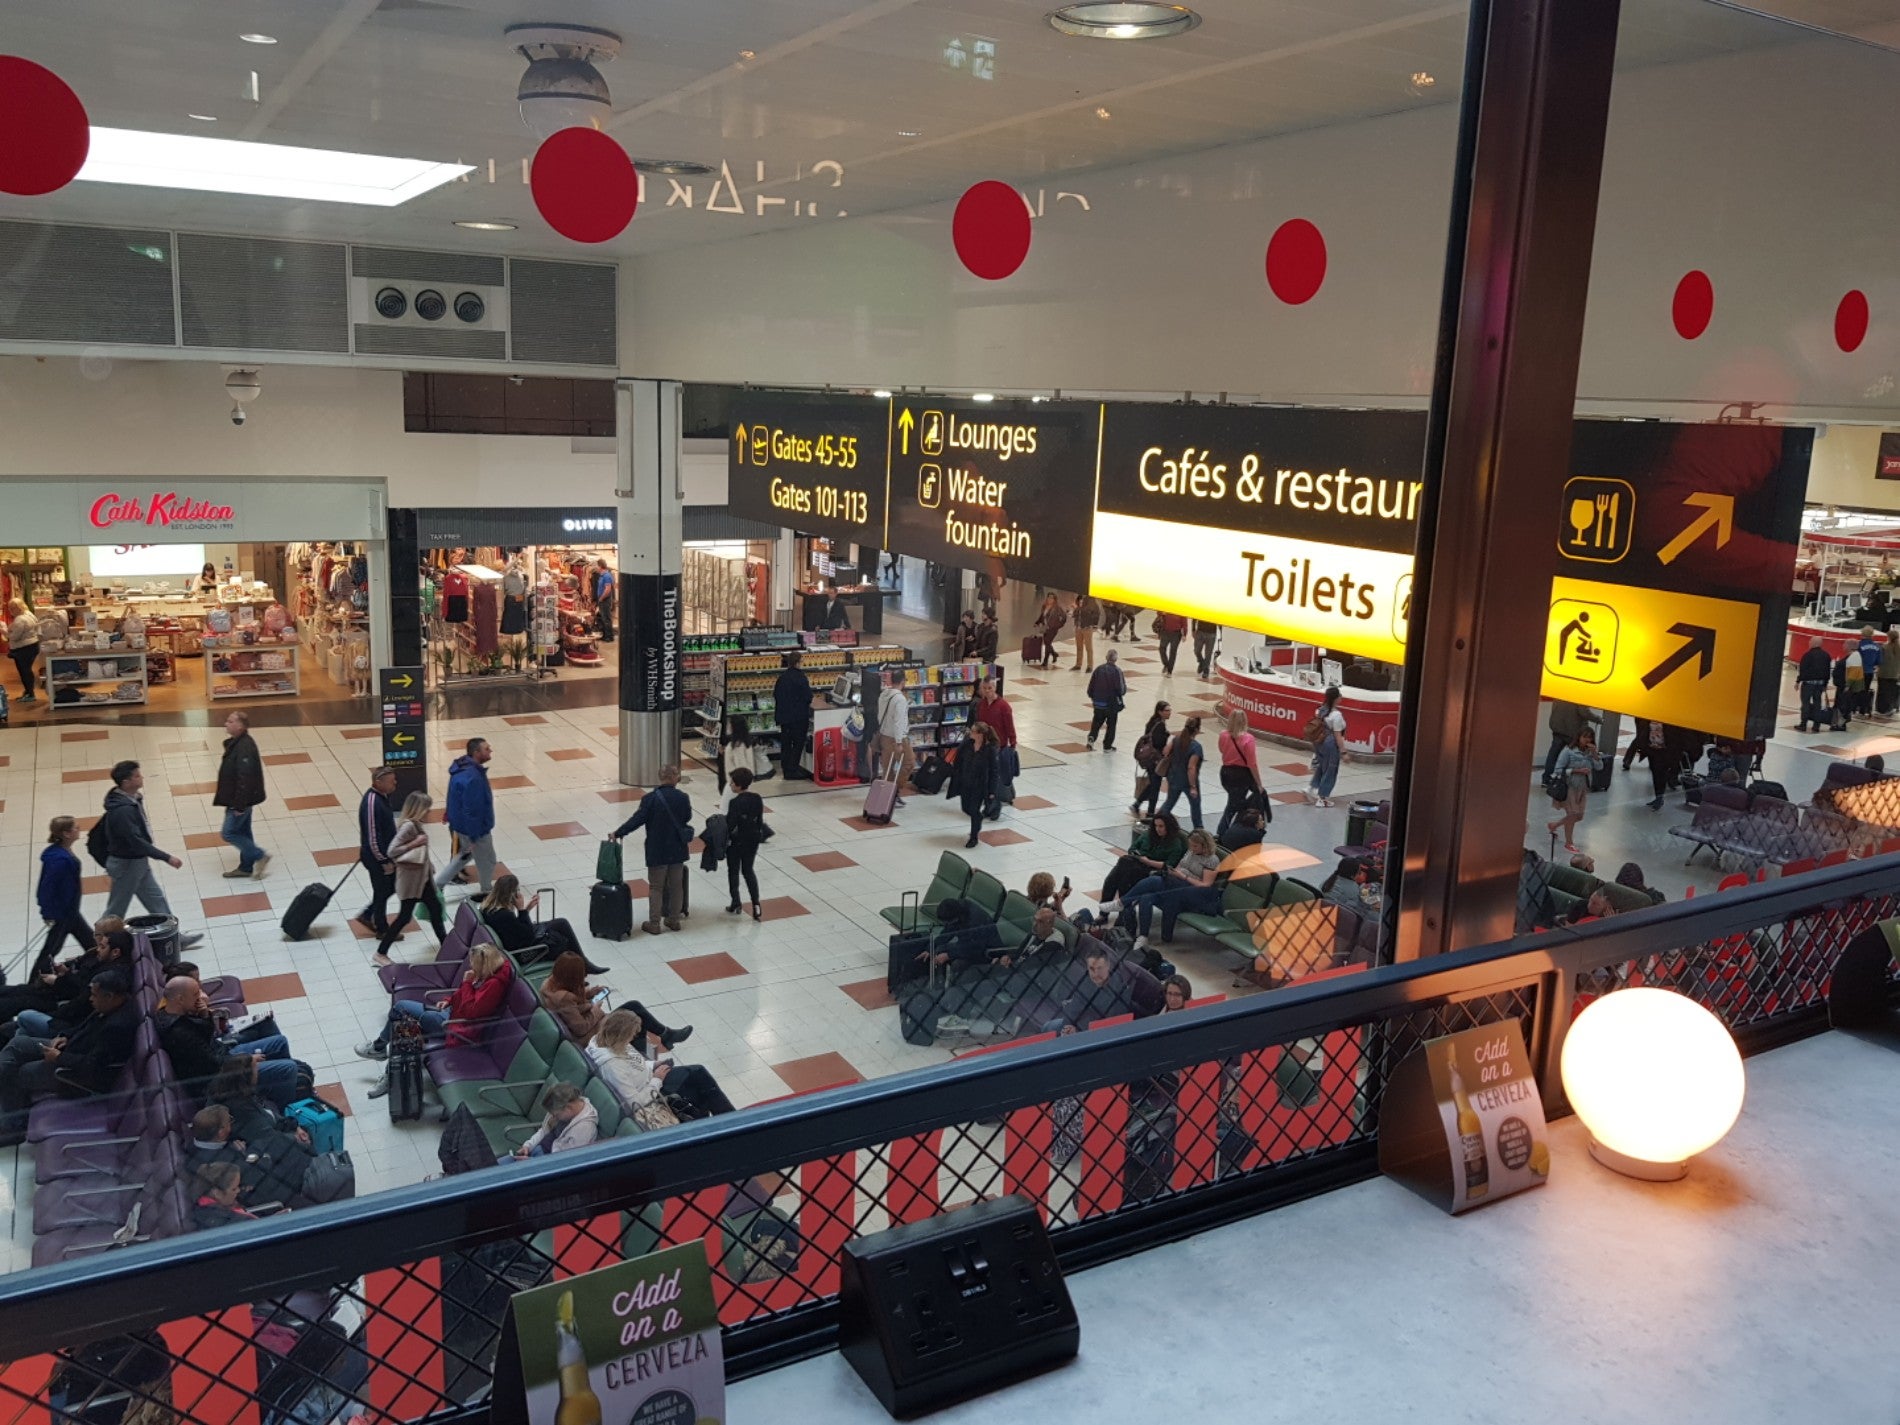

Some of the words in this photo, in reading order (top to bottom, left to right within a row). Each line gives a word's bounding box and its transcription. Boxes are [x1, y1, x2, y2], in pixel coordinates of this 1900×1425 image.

[772, 429, 812, 463] Gates
[815, 434, 857, 469] 45-55
[950, 414, 1037, 461] Lounges
[948, 468, 1007, 507] Water
[1139, 447, 1228, 500] Cafés
[1235, 454, 1264, 504] &
[89, 493, 144, 528] Cath
[145, 492, 235, 526] Kidston
[770, 477, 811, 513] Gates
[815, 486, 868, 524] 101-113
[563, 519, 613, 531] OLIVER
[945, 510, 1031, 558] fountain
[1241, 551, 1375, 620] Toilets
[661, 587, 677, 700] TheBookshop
[648, 659, 658, 709] WHSmith
[1474, 1035, 1510, 1063] Add
[1481, 1067, 1499, 1083] on
[1502, 1061, 1512, 1077] a
[1477, 1082, 1533, 1112] CERVEZA
[612, 1268, 682, 1316] Add
[620, 1315, 655, 1345] on
[662, 1308, 682, 1331] a
[605, 1333, 709, 1390] CERVEZA
